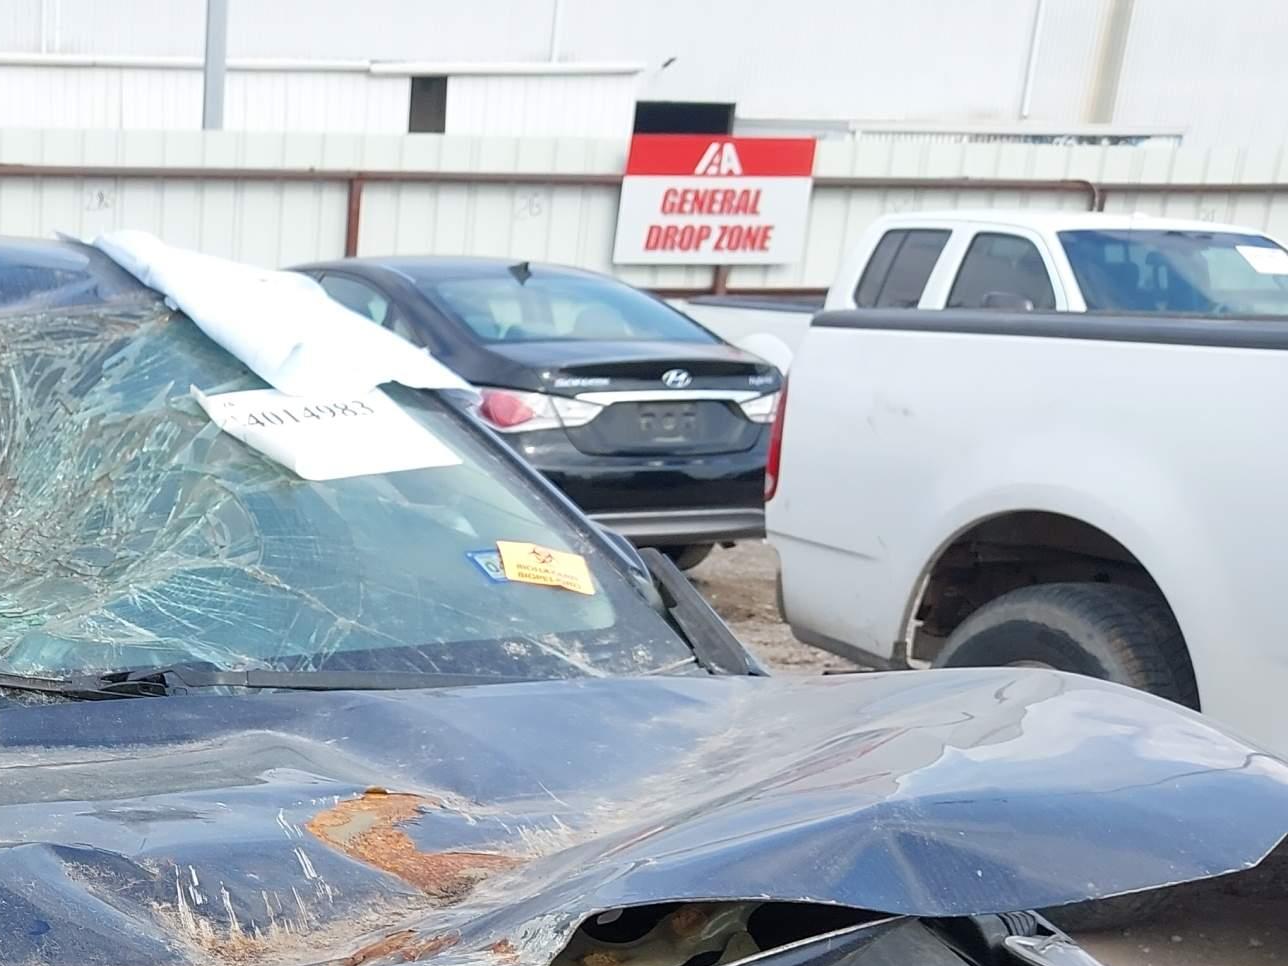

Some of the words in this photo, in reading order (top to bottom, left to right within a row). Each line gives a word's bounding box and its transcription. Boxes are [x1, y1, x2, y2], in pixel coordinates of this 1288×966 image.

[660, 187, 762, 215] GENERAL
[644, 223, 712, 251] DROP
[714, 224, 774, 251] ZONE
